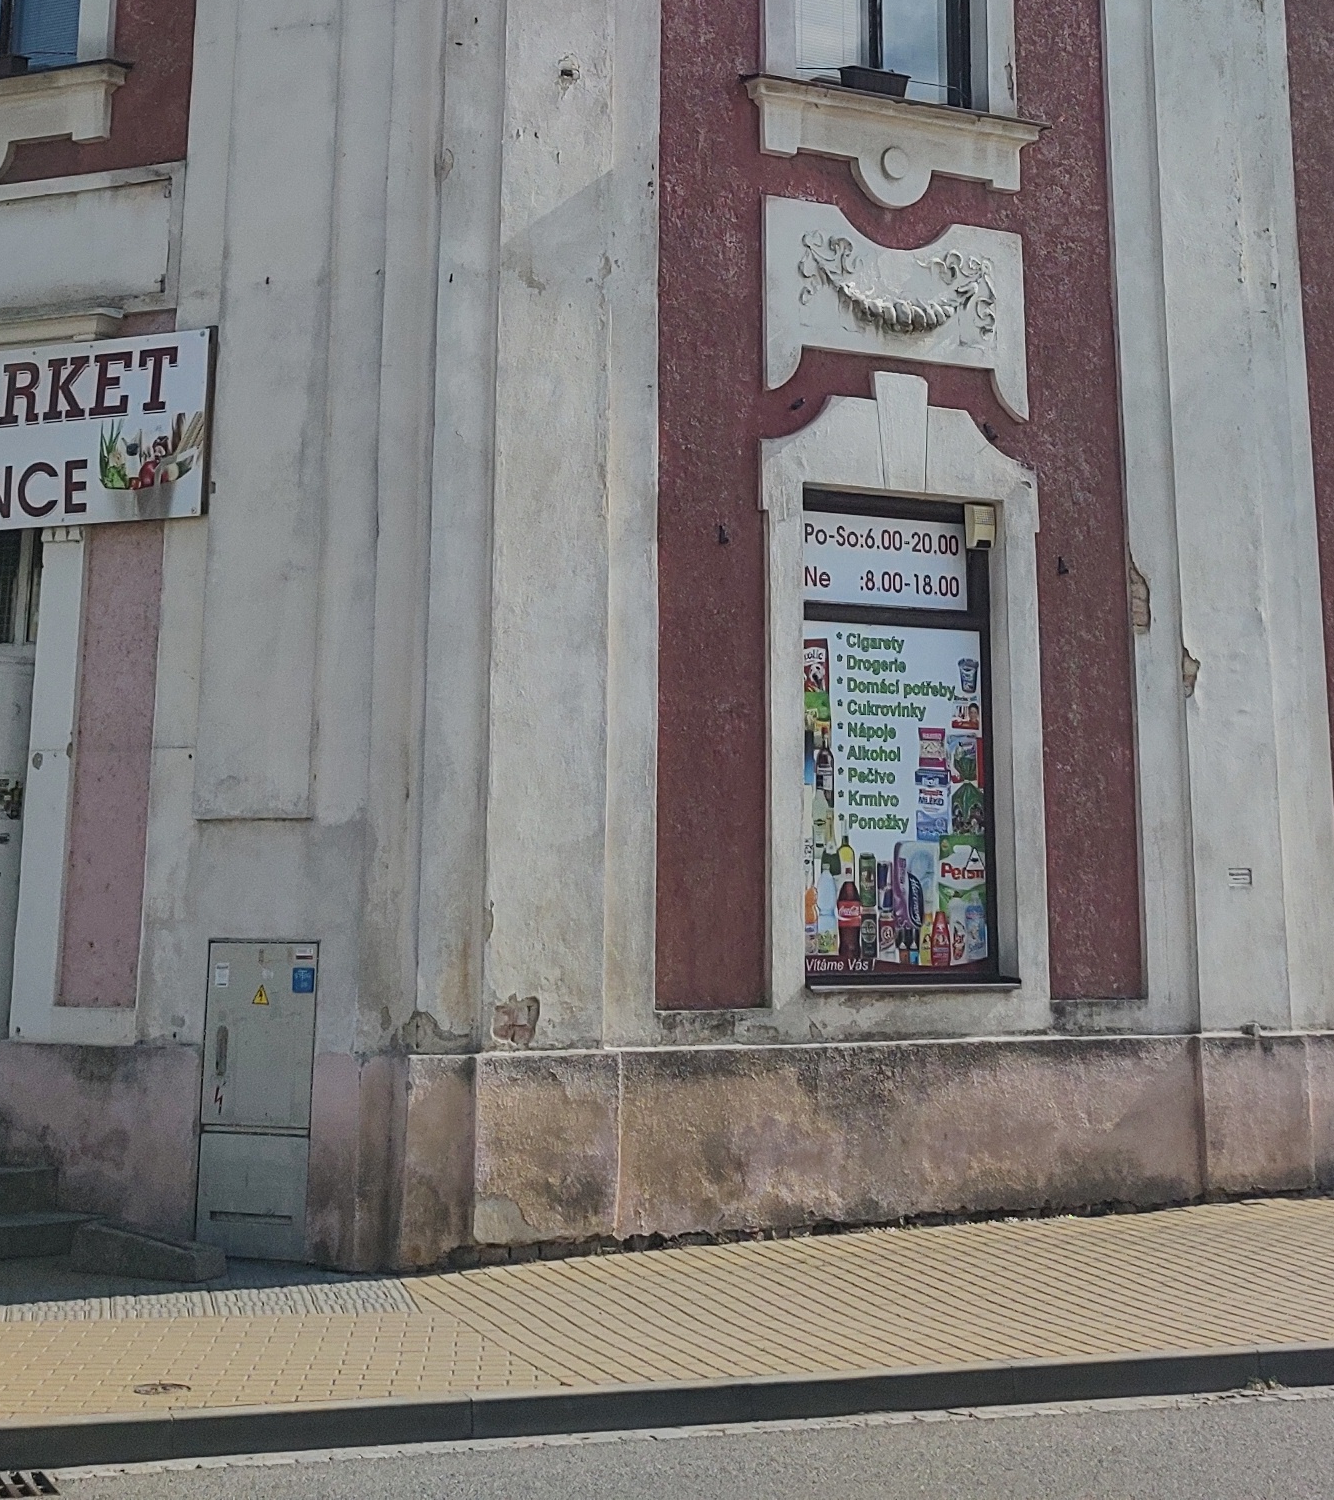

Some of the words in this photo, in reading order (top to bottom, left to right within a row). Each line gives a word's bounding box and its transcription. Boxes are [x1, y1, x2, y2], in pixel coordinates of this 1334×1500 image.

[804, 522, 959, 556] Po-So:6.00-20.00
[804, 565, 831, 588] Ne
[846, 632, 905, 654] Cigarety
[846, 654, 907, 675] Drogerie
[847, 676, 900, 695] Domácí
[903, 680, 956, 701] potřeby
[847, 698, 926, 722] Cukrovinky
[847, 721, 897, 742] Nápoje
[847, 744, 901, 762] Alkohol
[847, 766, 896, 785] Pečivo
[848, 789, 900, 807] Krmivo
[848, 812, 910, 834] Ponožky
[805, 958, 844, 972] Vítáme
[847, 958, 869, 971] Vás
